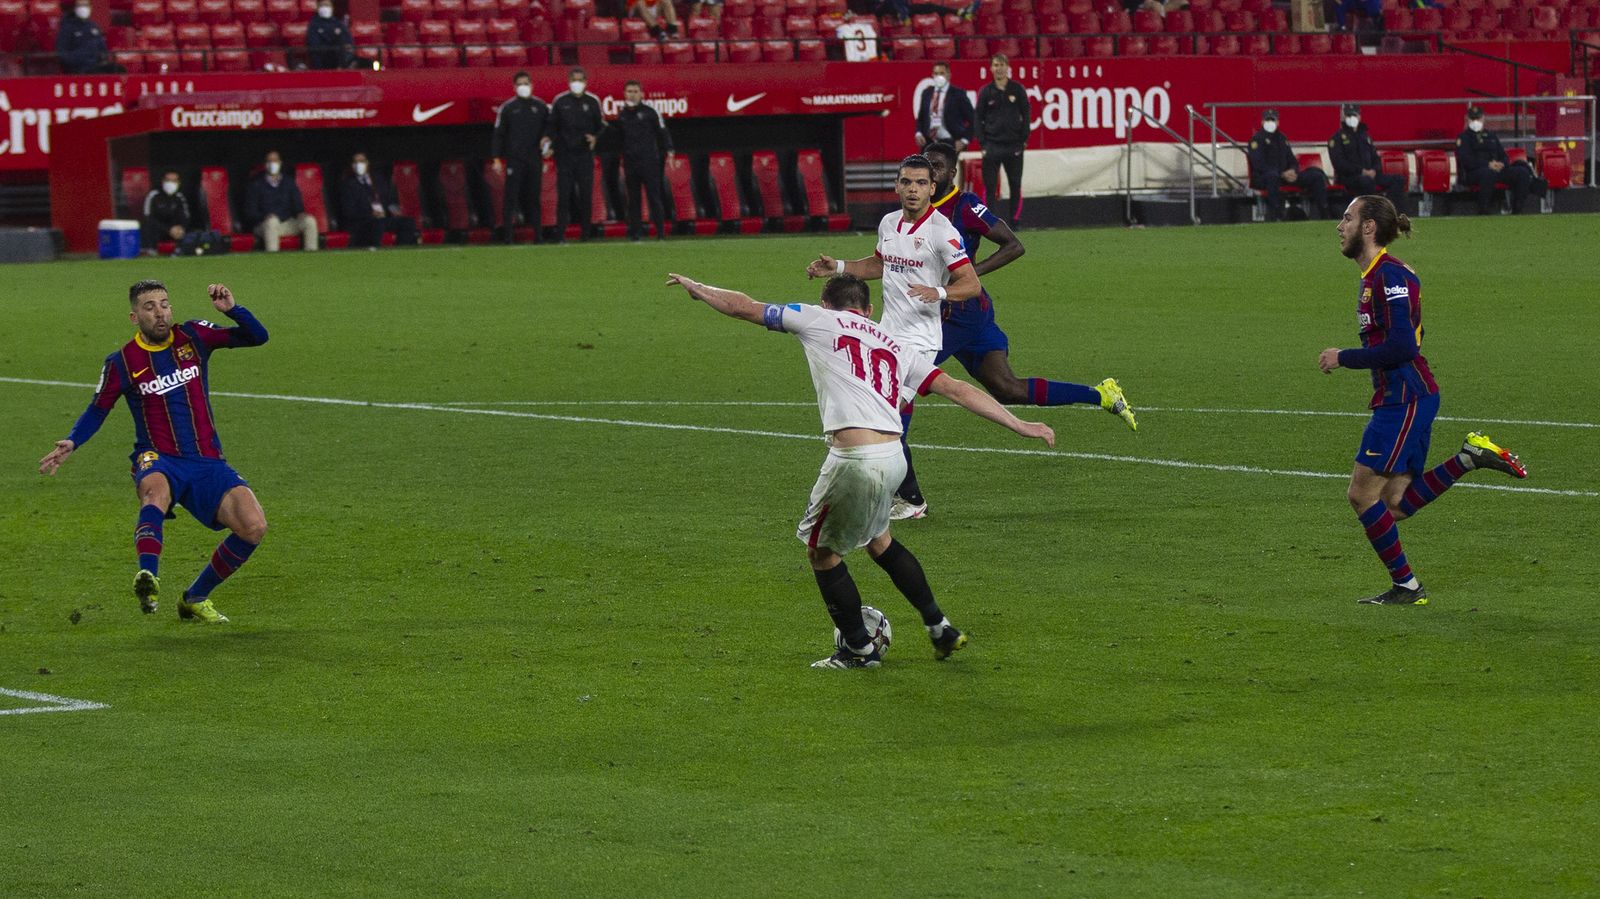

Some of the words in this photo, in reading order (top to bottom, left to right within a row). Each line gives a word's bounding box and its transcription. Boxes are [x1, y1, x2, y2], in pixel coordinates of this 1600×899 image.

[855, 30, 866, 51] 3
[980, 66, 1039, 79] DSDE
[812, 93, 884, 105] MARATHONBET
[913, 77, 1171, 139] campo
[171, 107, 263, 128] Cruzcampo
[882, 255, 924, 268] ARATHON
[890, 264, 904, 273] BET
[1384, 285, 1408, 295] beko
[139, 365, 199, 395] Rakuten
[833, 334, 899, 409] 10
